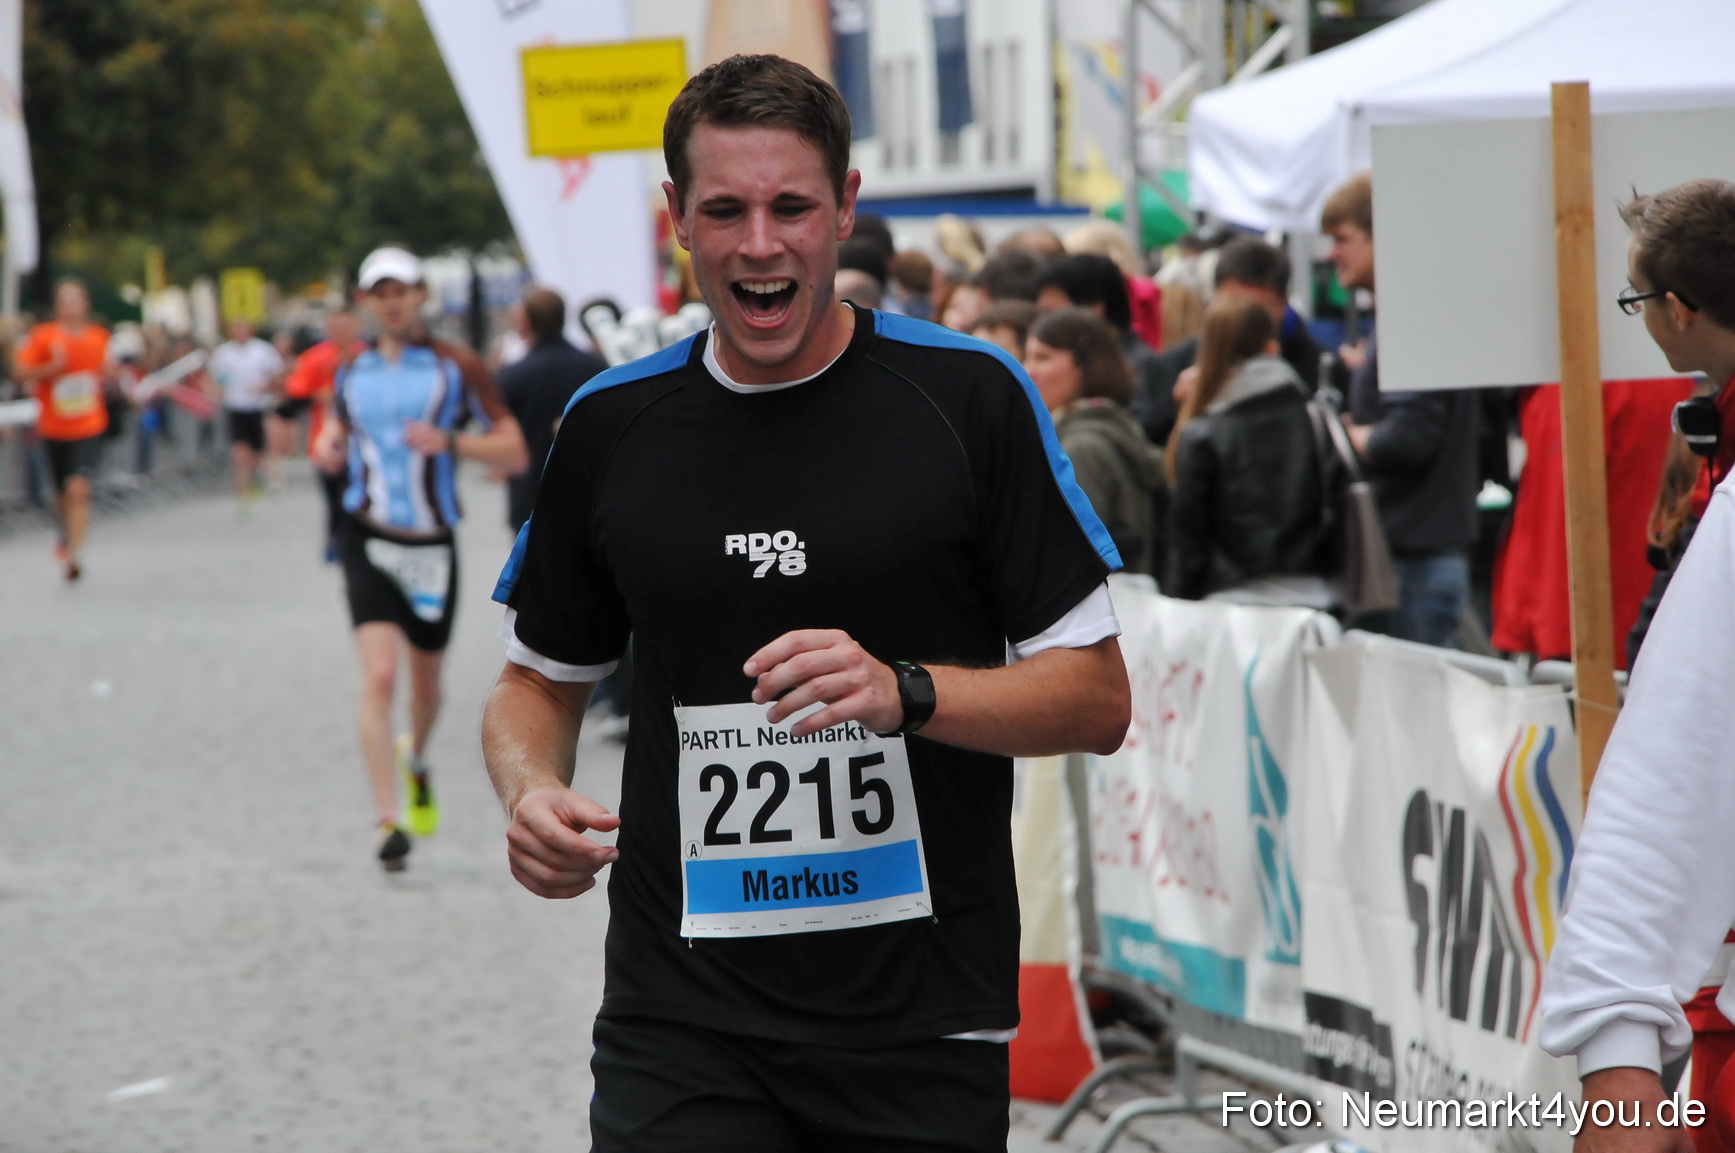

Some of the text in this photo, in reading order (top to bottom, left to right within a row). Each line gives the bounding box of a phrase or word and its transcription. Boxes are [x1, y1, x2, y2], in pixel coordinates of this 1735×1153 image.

[725, 530, 805, 555] RDO.
[749, 550, 807, 578] 78
[682, 722, 867, 750] PARTL Neumarkt
[699, 751, 895, 847] 2215
[689, 843, 699, 858] A
[742, 867, 860, 903] Markus
